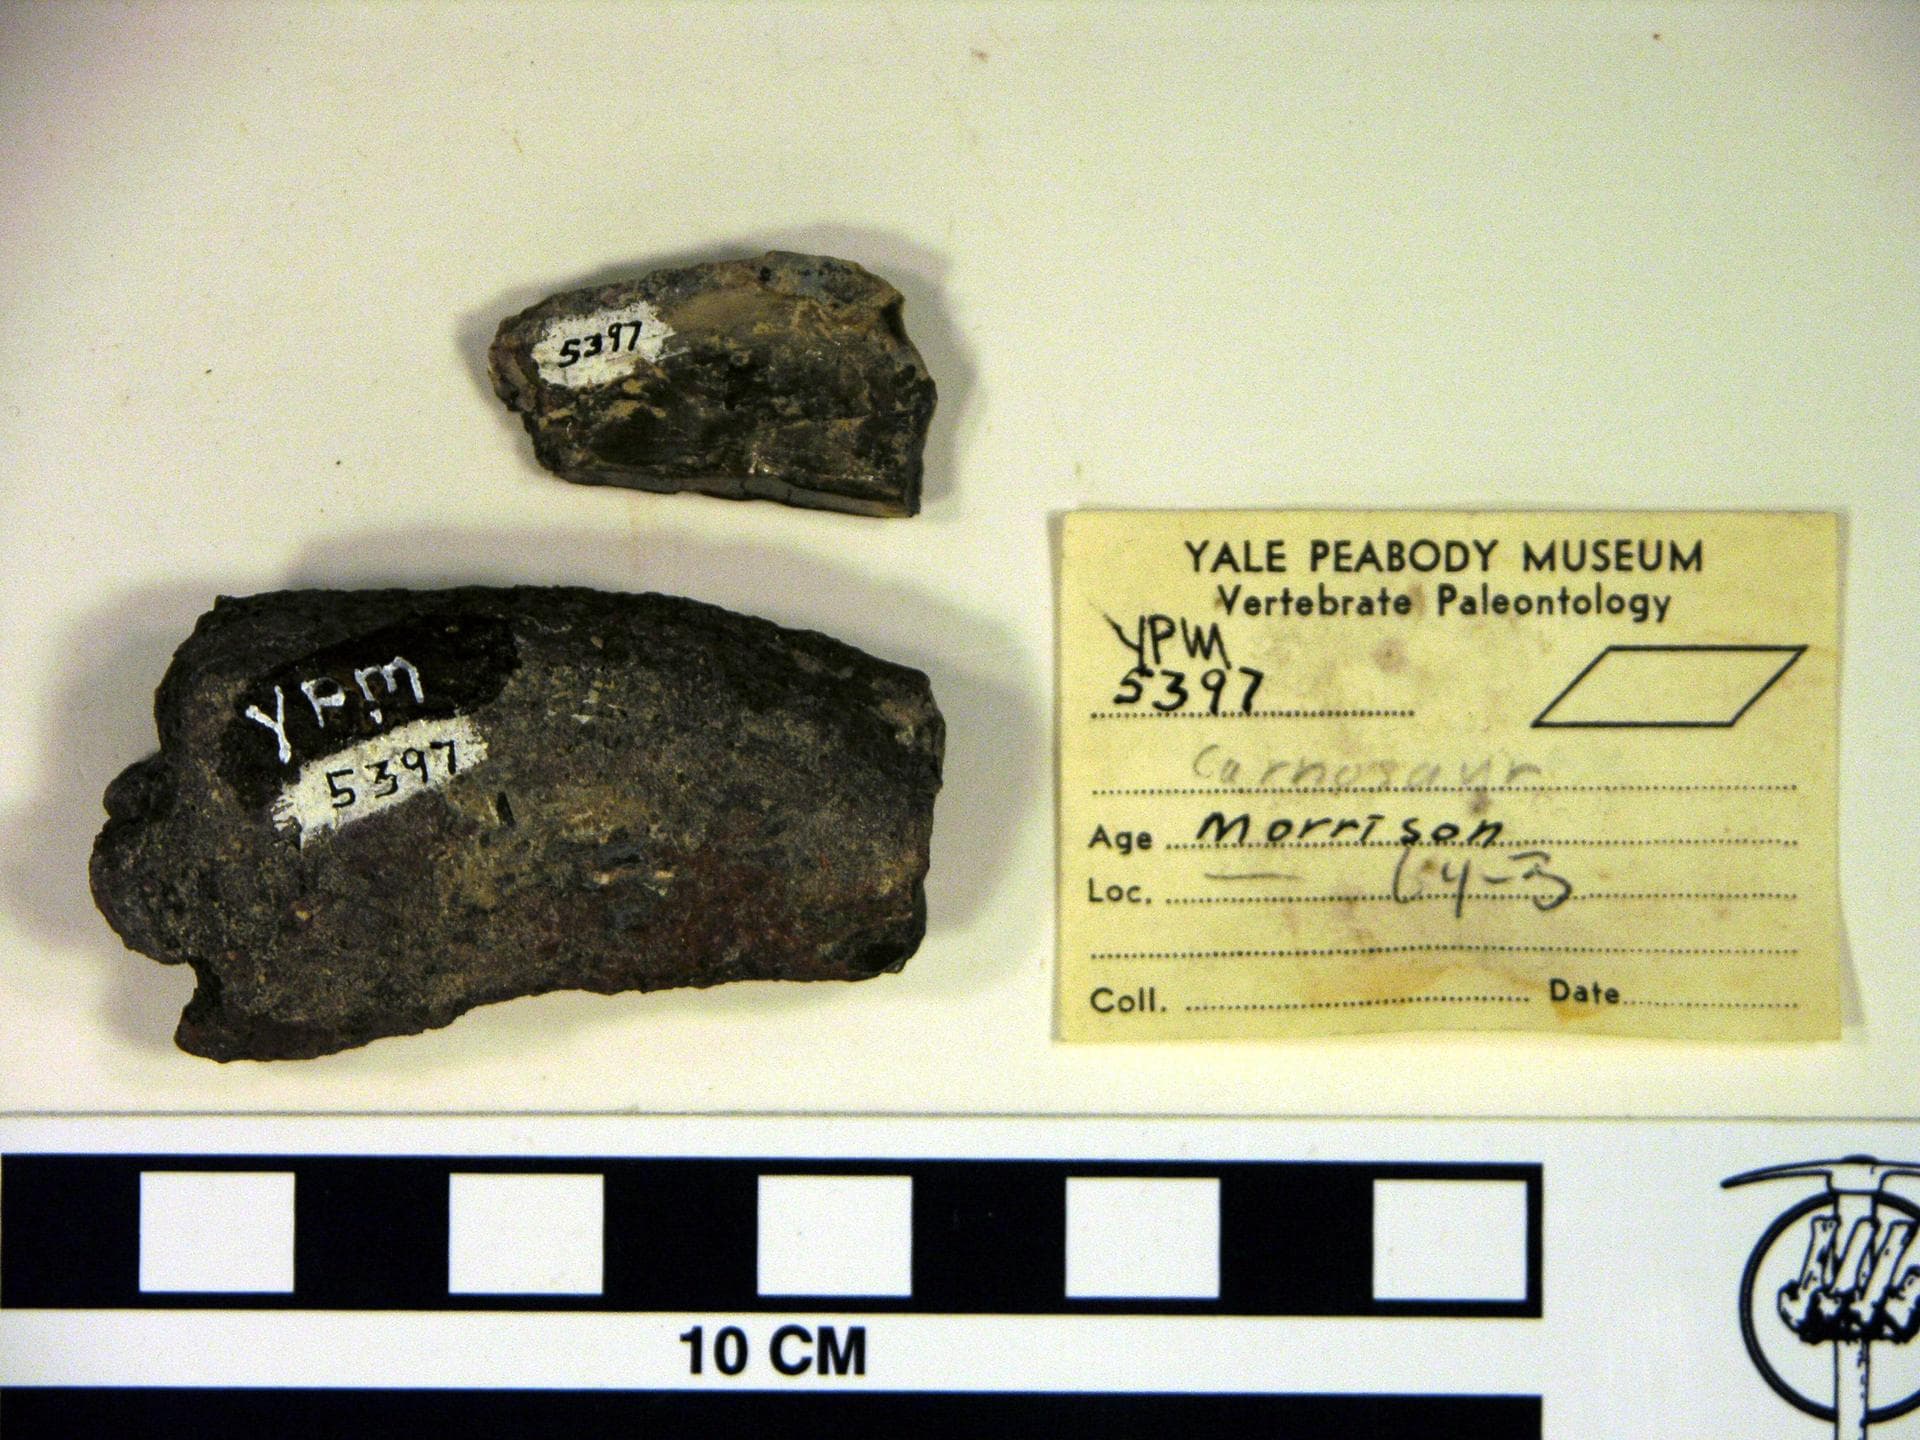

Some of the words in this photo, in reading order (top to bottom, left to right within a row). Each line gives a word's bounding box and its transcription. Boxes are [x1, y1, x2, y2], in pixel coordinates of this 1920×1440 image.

[558, 320, 643, 368] 5397
[1185, 540, 1287, 573] YALE
[1310, 540, 1500, 573] PEABODY
[1523, 540, 1704, 572] MUSEUM
[1217, 585, 1413, 617] Vertebrate
[1438, 584, 1672, 623] Paleontology
[1103, 613, 1232, 673] YPM
[1113, 666, 1264, 714] 5397
[326, 739, 455, 808] 5397
[1089, 826, 1154, 858] Age
[1196, 811, 1504, 849] Morrison
[1089, 879, 1152, 906] Loc.
[1090, 989, 1168, 1014] Coll.
[1550, 980, 1620, 1005] Date
[680, 1325, 748, 1375] 10
[769, 1324, 866, 1375] CM
